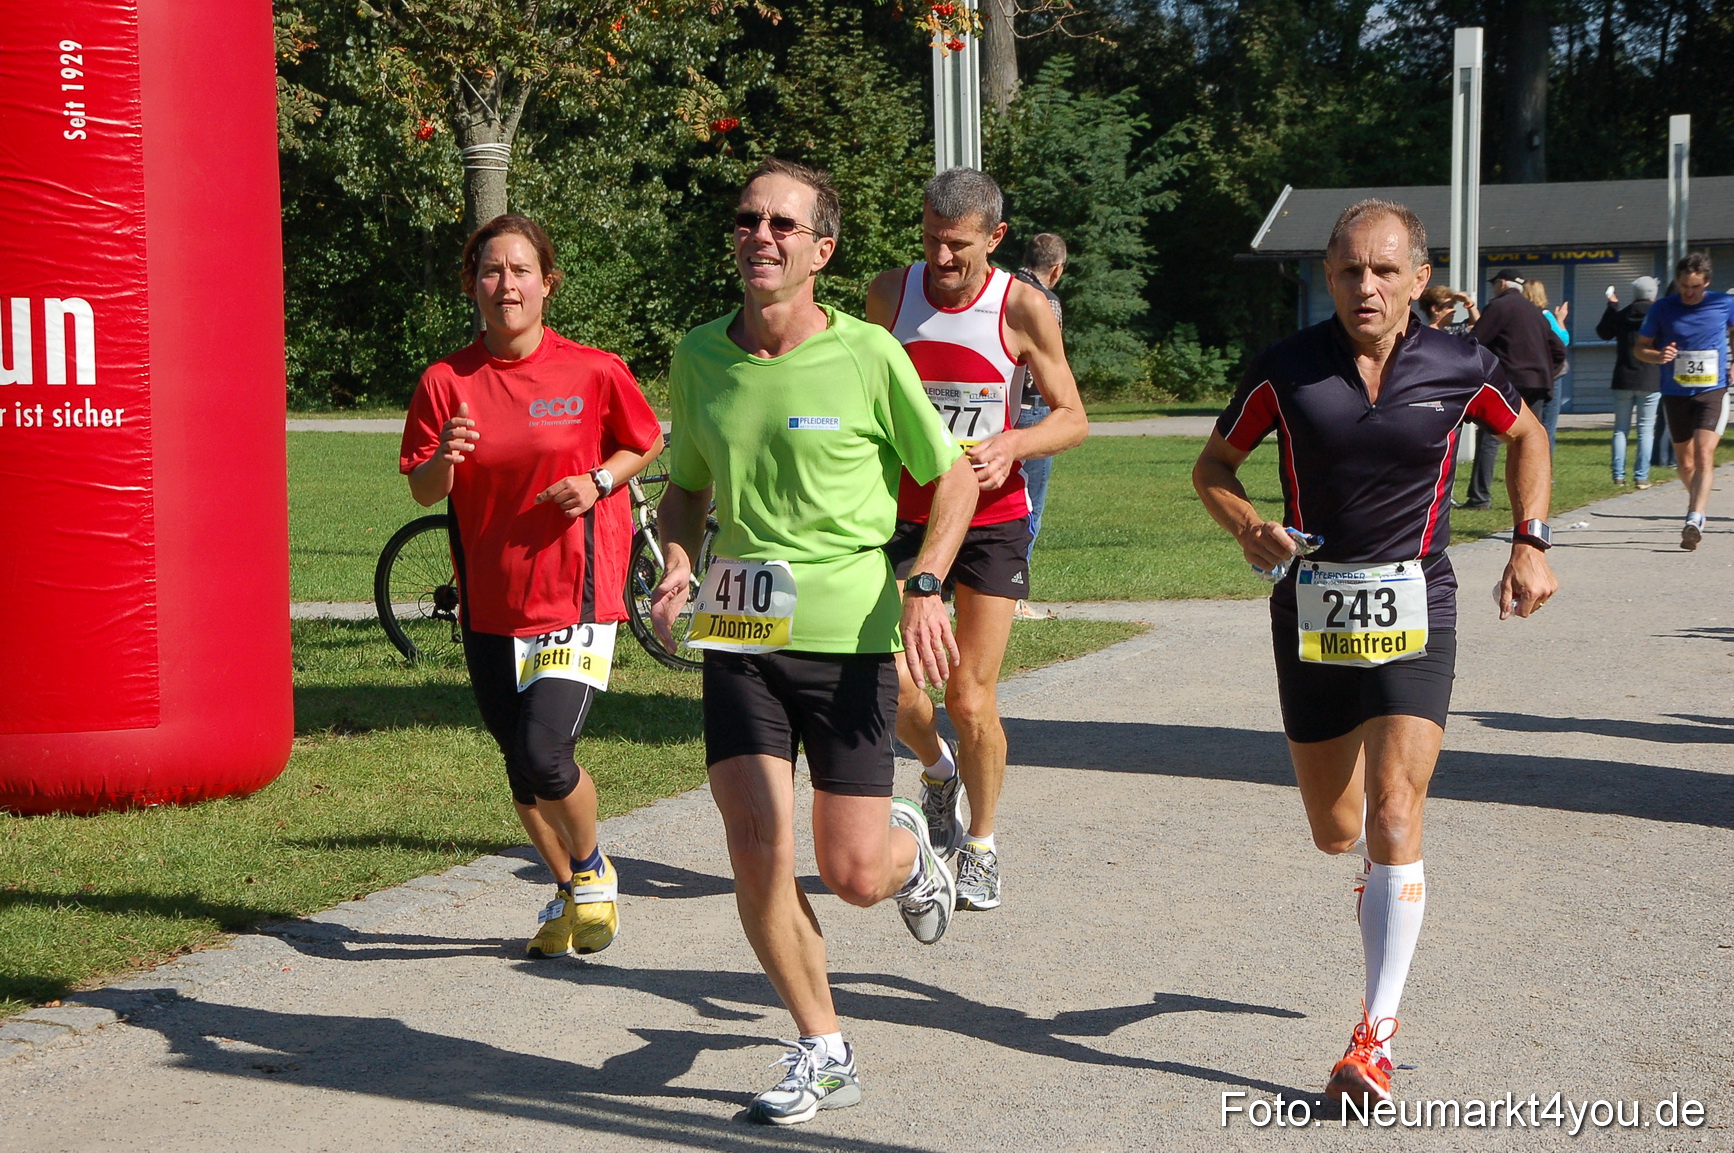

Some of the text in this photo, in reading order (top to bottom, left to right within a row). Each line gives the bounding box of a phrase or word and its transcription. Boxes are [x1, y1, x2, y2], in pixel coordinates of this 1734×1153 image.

[59, 40, 87, 140] Seit 1929
[1687, 360, 1704, 374] 34
[925, 387, 961, 398] LEIDERER
[15, 401, 44, 428] ist
[52, 397, 125, 428] sicher
[529, 396, 584, 419] eco
[932, 402, 982, 437] 77
[800, 417, 839, 425] PFLEIDERER
[1314, 570, 1366, 580] PFLEIDERER
[715, 568, 774, 613] 410
[1322, 587, 1398, 629] 243
[708, 614, 774, 640] Thomas
[1320, 631, 1407, 655] Manfred
